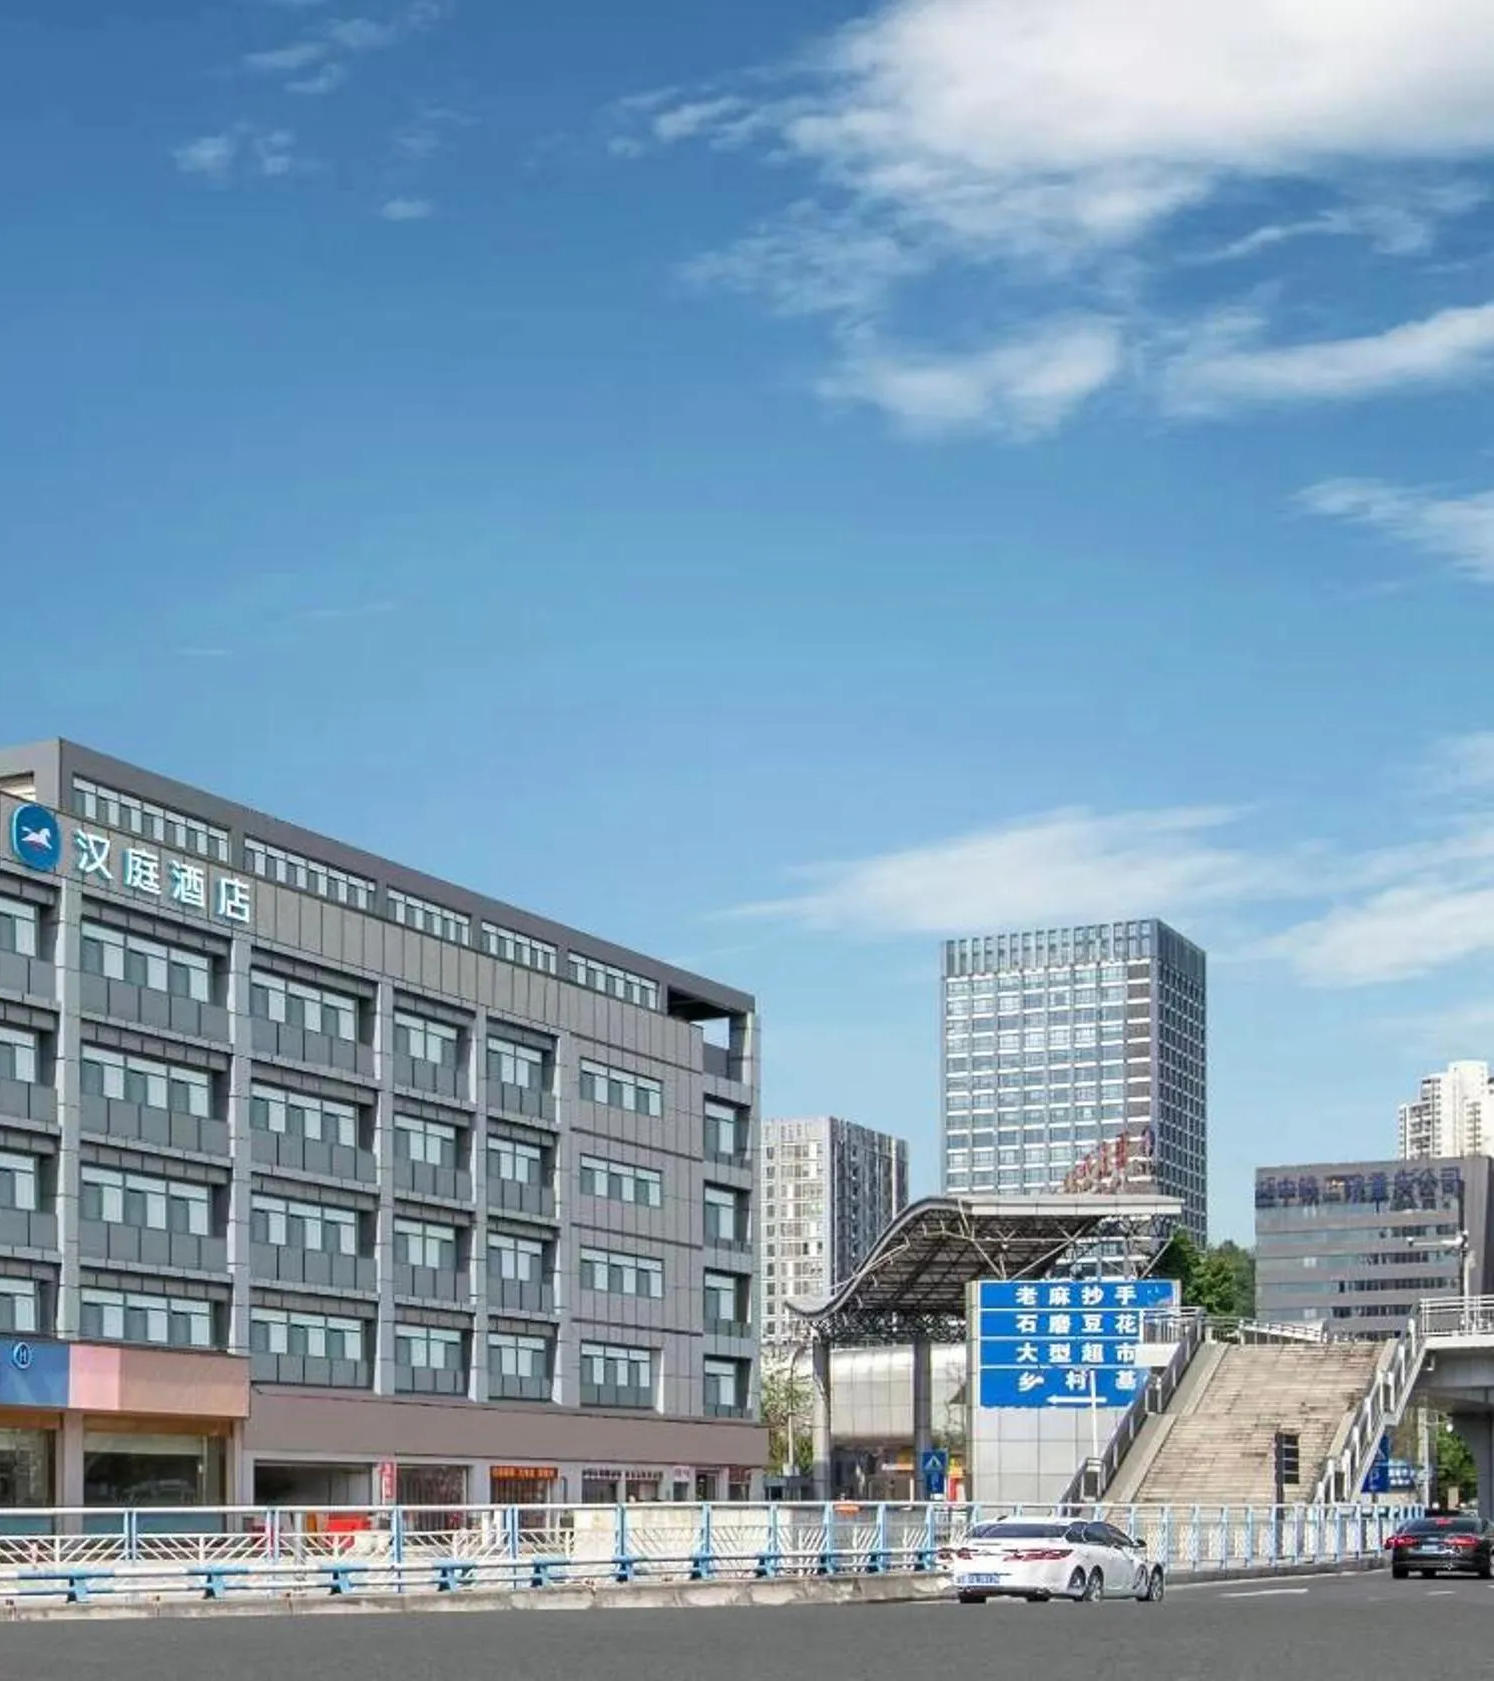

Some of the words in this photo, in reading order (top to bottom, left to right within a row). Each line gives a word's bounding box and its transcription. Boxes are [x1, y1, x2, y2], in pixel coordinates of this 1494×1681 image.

[73, 828, 250, 923] 汉庭酒店
[1015, 1286, 1137, 1306] 老麻抄手
[1016, 1314, 1137, 1334] 石磨豆花
[1016, 1342, 1136, 1363] 大型超市
[1018, 1370, 1137, 1392] 乡村基
